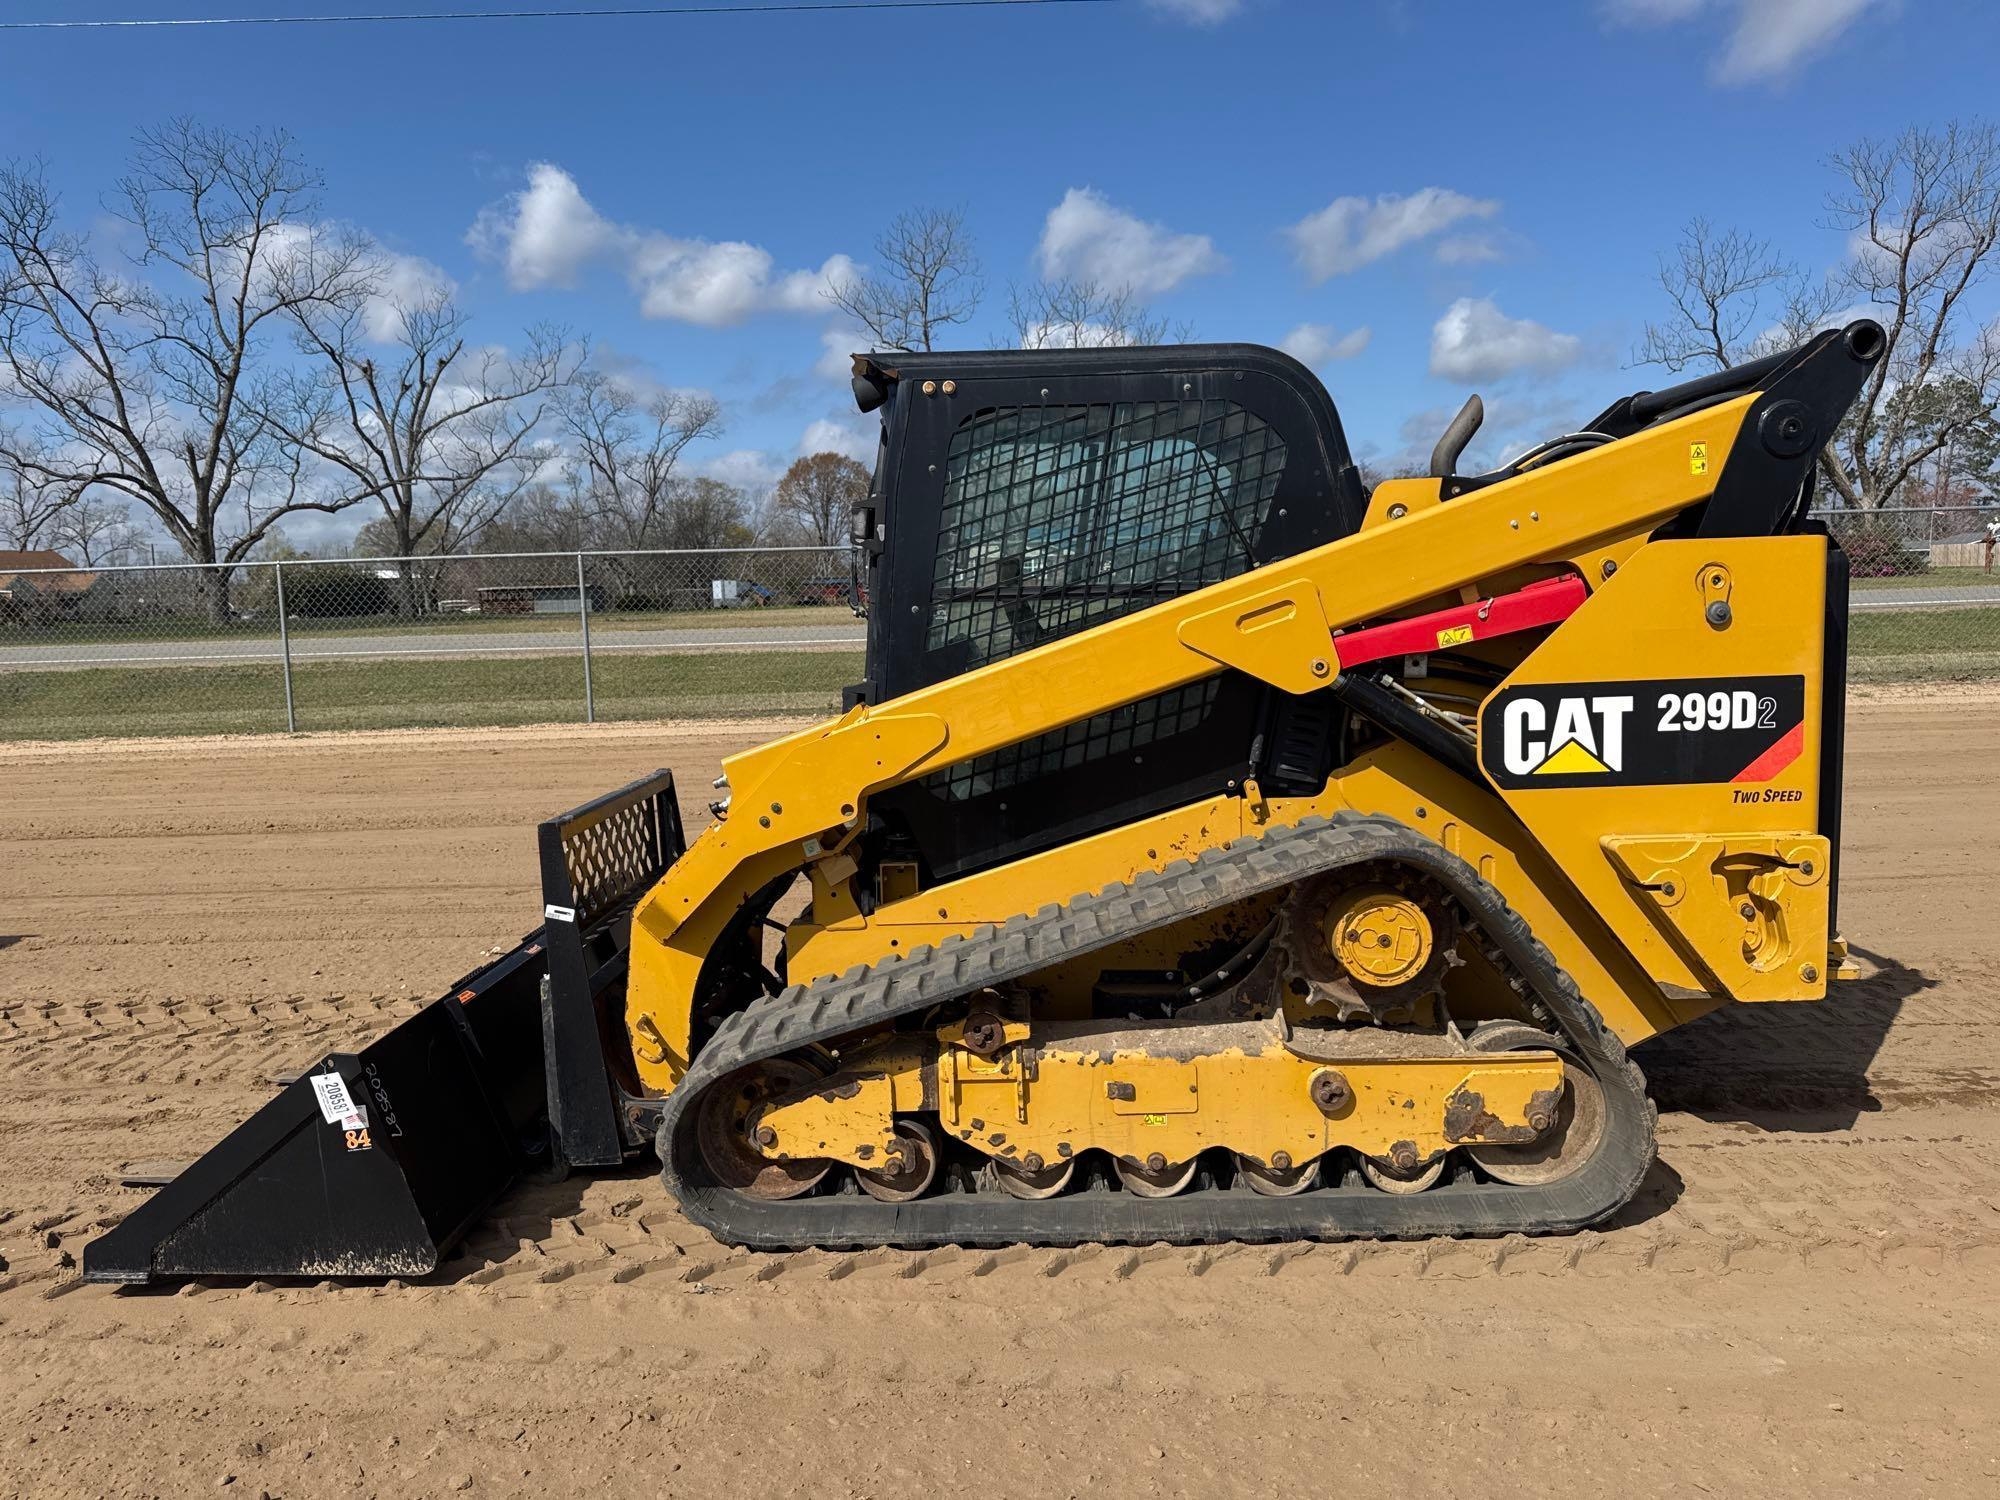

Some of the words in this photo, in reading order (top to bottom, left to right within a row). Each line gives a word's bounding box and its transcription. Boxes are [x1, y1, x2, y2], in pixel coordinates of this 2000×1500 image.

[1503, 695, 1634, 776] CAT
[1656, 690, 1777, 732] 299D2
[325, 1081, 350, 1115] 208587
[365, 1062, 403, 1137] 208587
[345, 1128, 372, 1149] 84
